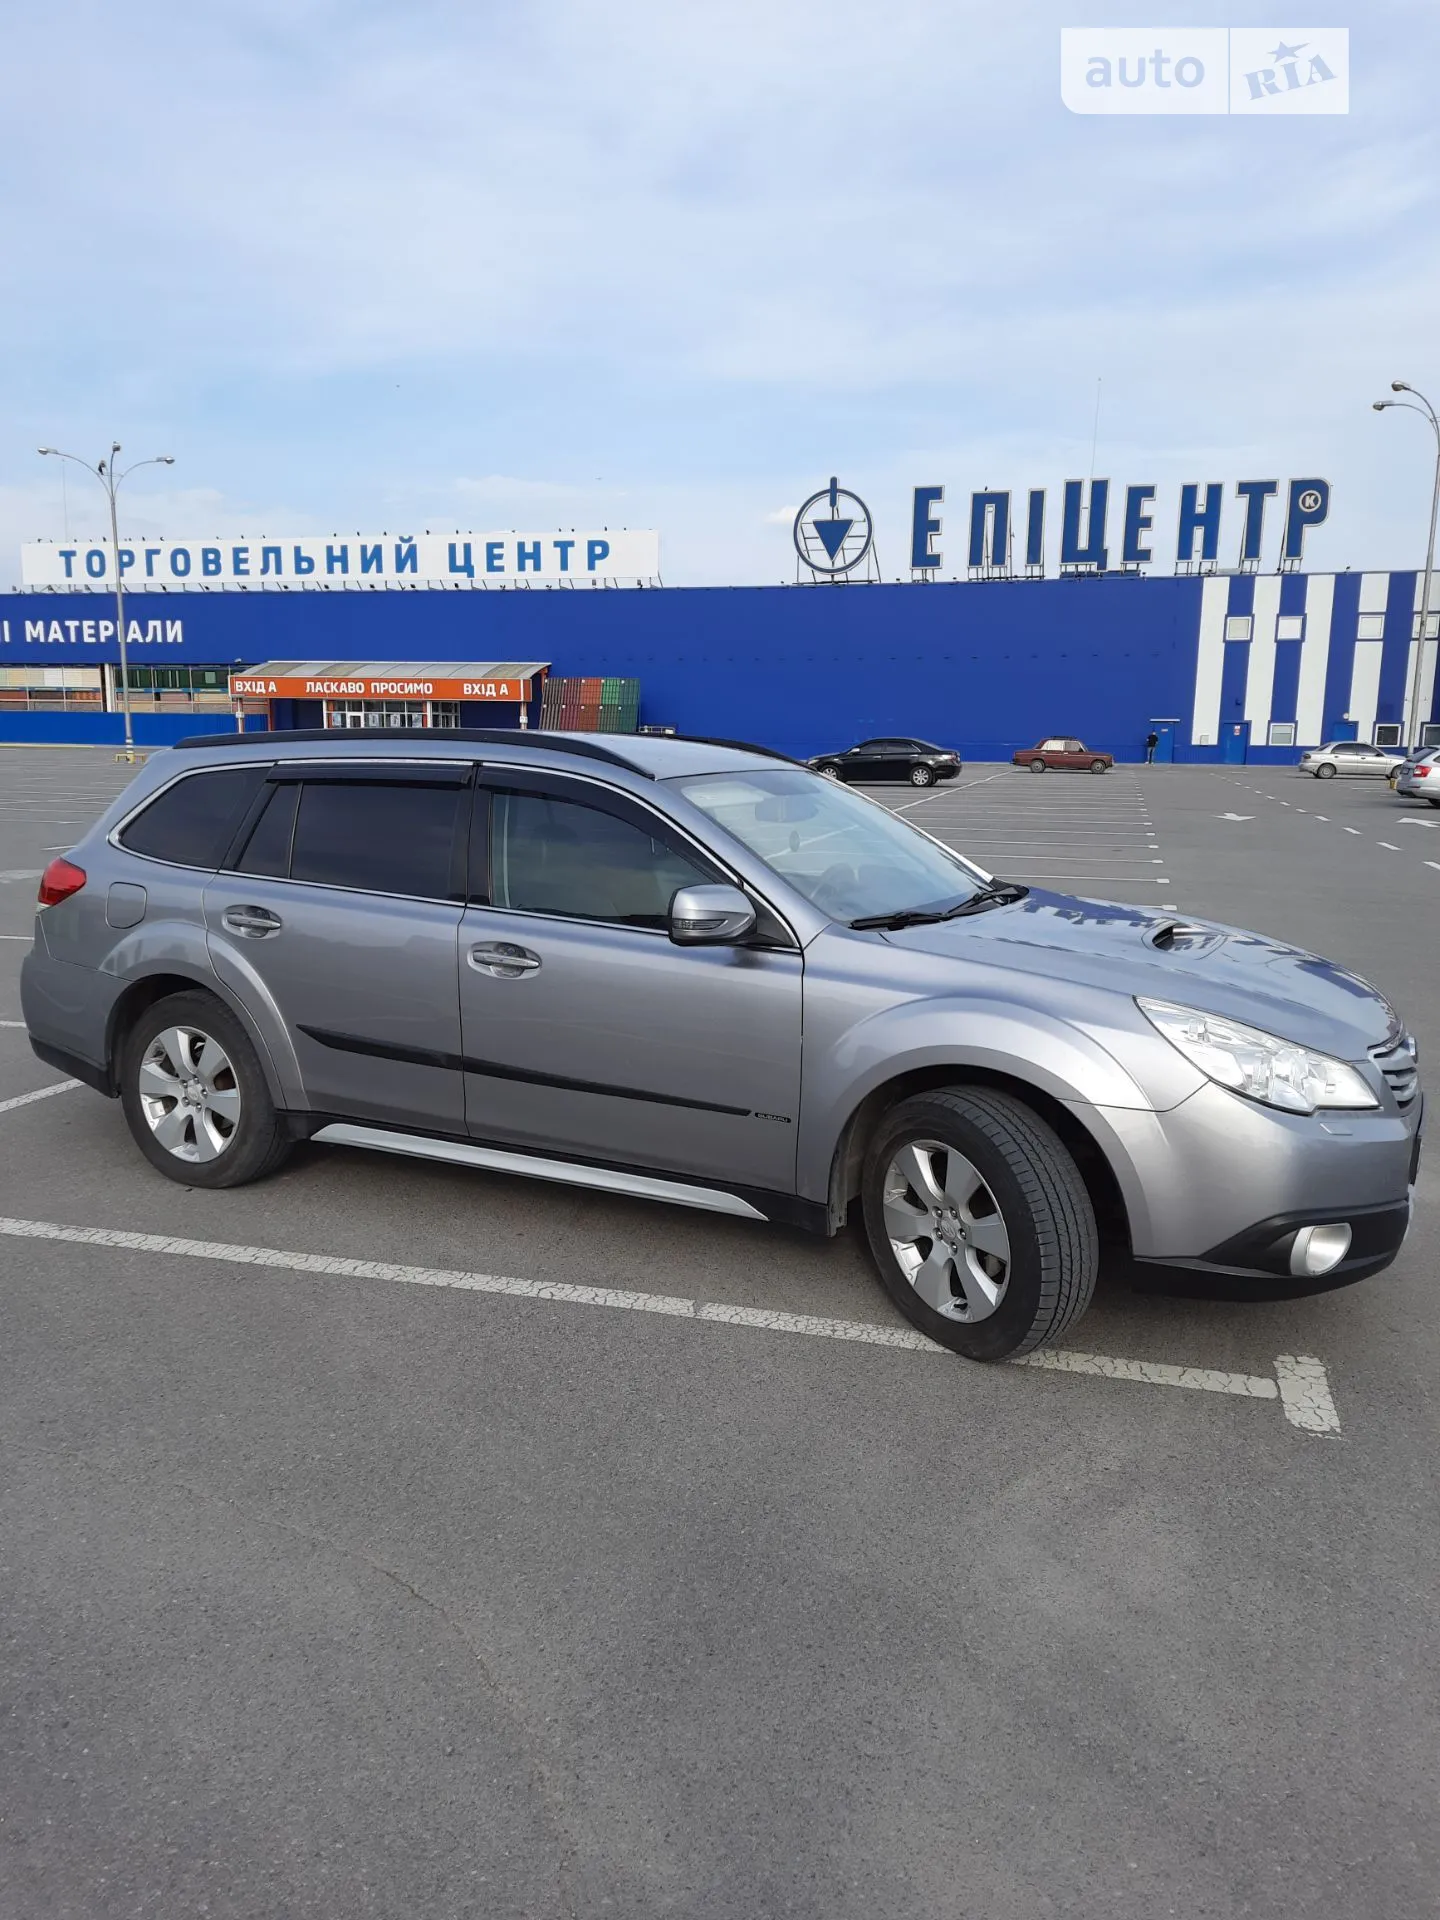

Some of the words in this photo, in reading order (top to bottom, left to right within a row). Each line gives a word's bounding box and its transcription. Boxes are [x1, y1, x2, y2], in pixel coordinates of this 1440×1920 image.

[909, 477, 1331, 570] ЕПІЦЕНТР
[58, 536, 418, 578] ТОРГОВЕЛЬНИЙ
[448, 539, 610, 578] ЦЕНТР
[235, 681, 266, 694] ВХІД
[268, 682, 277, 693] А
[305, 682, 365, 694] ЛАСКАВО
[371, 682, 433, 695] ПРОСИМО
[463, 683, 496, 697] ВХІД
[499, 683, 509, 695] А
